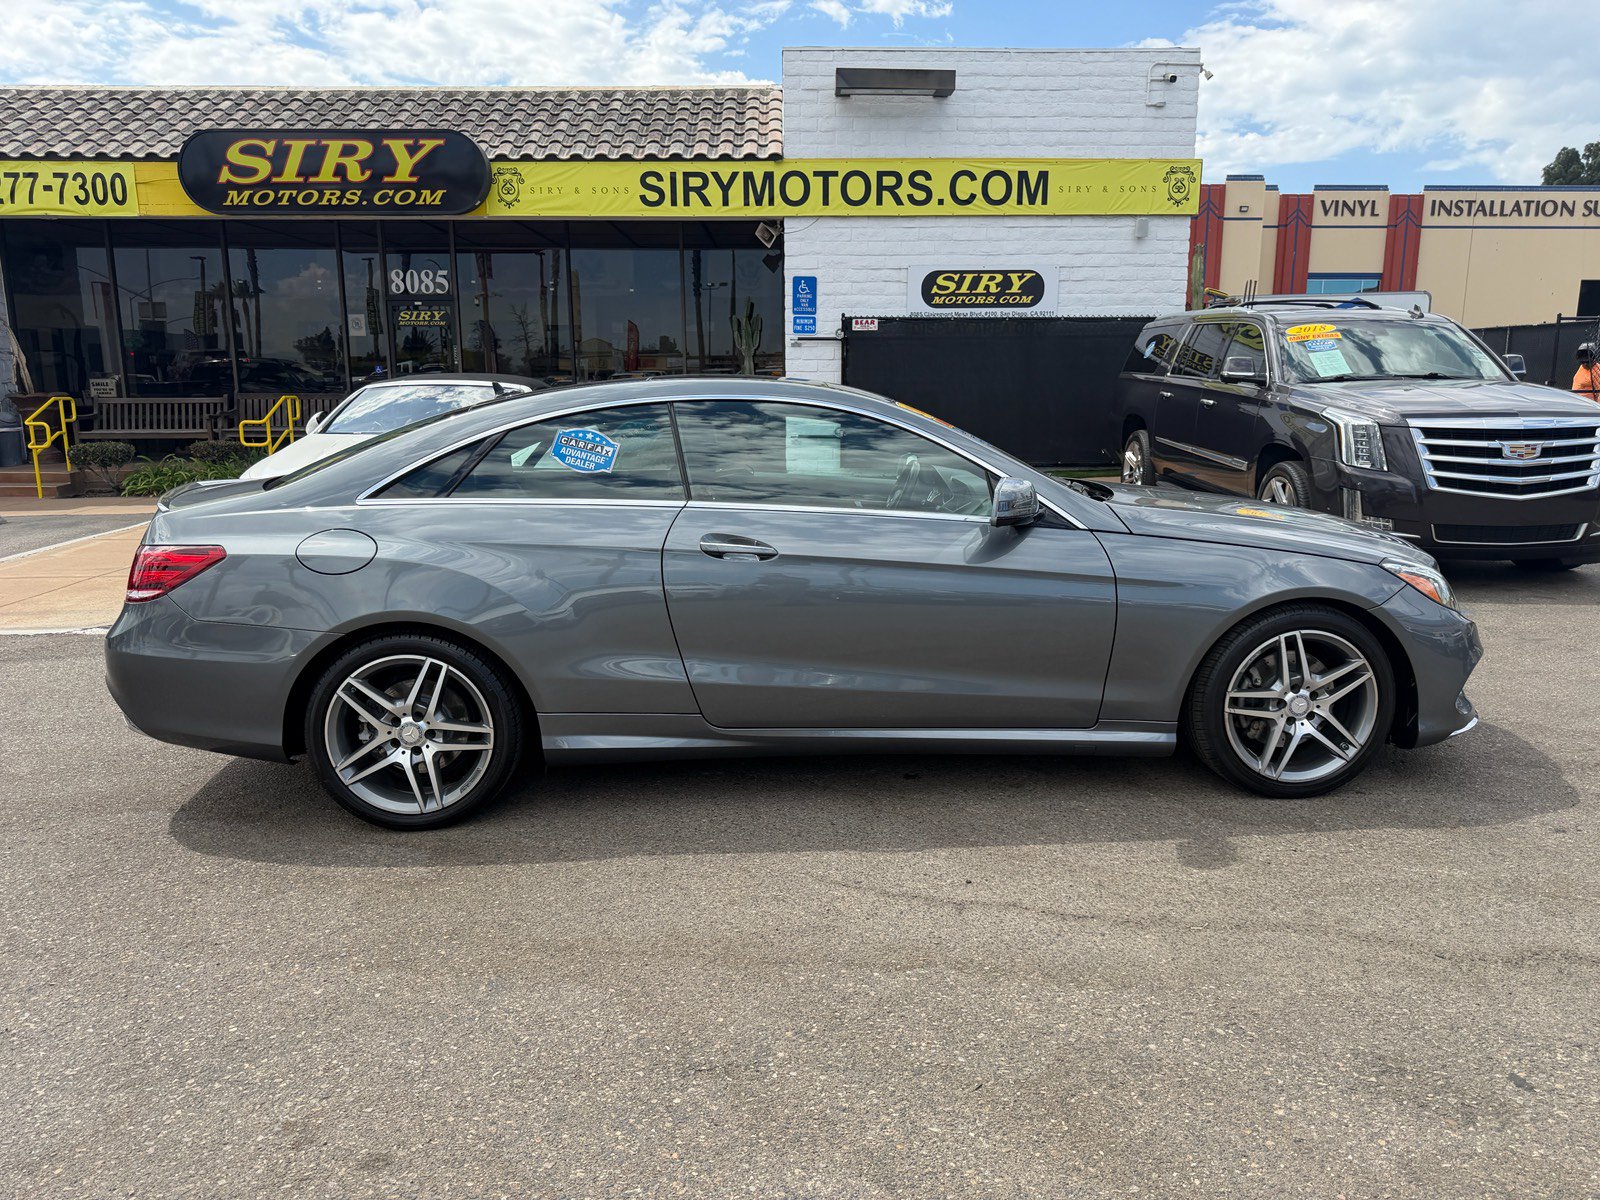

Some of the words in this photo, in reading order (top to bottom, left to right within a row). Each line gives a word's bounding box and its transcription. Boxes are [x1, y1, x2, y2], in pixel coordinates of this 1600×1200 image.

[217, 138, 446, 183] SIRY
[0, 171, 128, 206] 77-7300
[530, 186, 564, 194] SIRY
[574, 186, 581, 194] &
[592, 186, 630, 194] SONS
[639, 170, 1049, 207] SIRYMOTORS.COM
[1058, 185, 1093, 193] SIRY
[1102, 185, 1109, 193] &
[1119, 185, 1158, 193] SONS
[222, 189, 447, 206] MOTORS.COM
[1320, 200, 1380, 217] VINYL
[1430, 200, 1575, 217] INSTALLATION
[390, 269, 449, 294] 8085
[931, 273, 1036, 294] SIRY
[931, 295, 1034, 304] MOTORS.COM
[398, 311, 446, 321] SIRY
[1296, 324, 1327, 333] 2018
[559, 436, 613, 456] CARFAX
[560, 447, 606, 464] ADVANTAGE
[565, 457, 596, 470] DEALER
